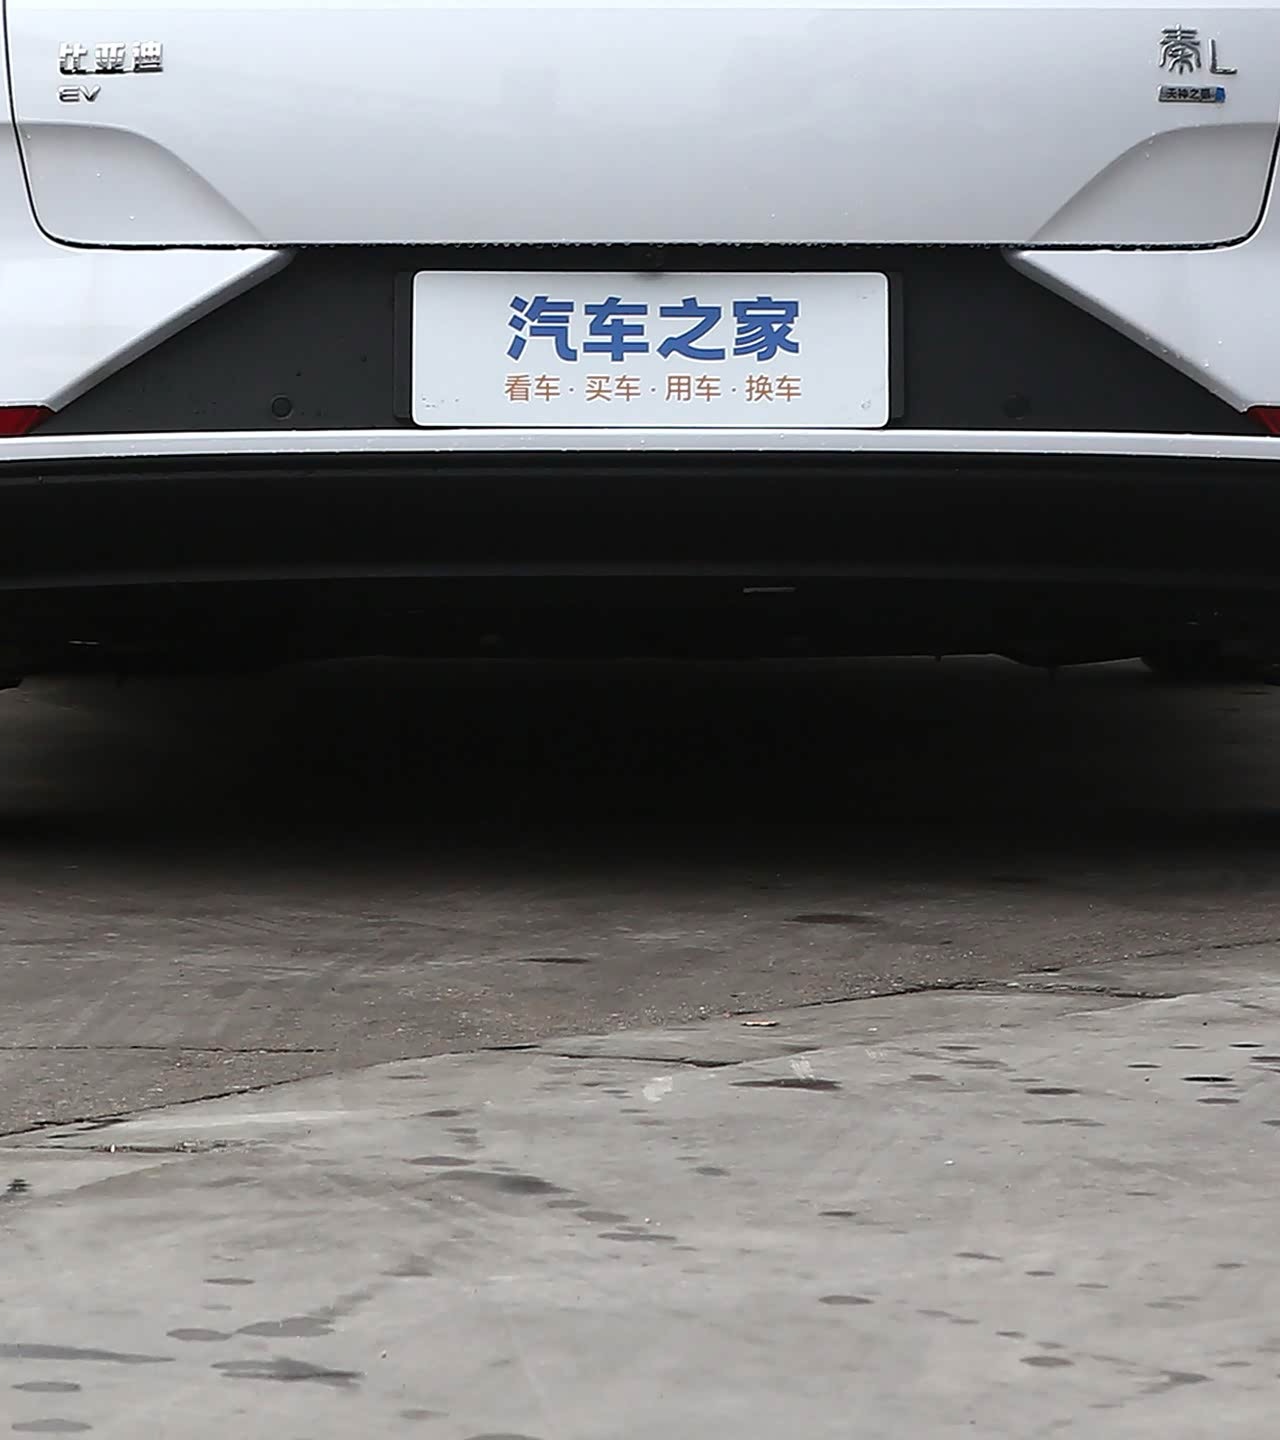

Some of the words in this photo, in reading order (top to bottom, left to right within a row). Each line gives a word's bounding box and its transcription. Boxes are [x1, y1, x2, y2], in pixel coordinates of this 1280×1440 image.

[58, 40, 164, 76] 比亚迪
[58, 85, 101, 103] EV
[506, 295, 800, 362] 汽车之家
